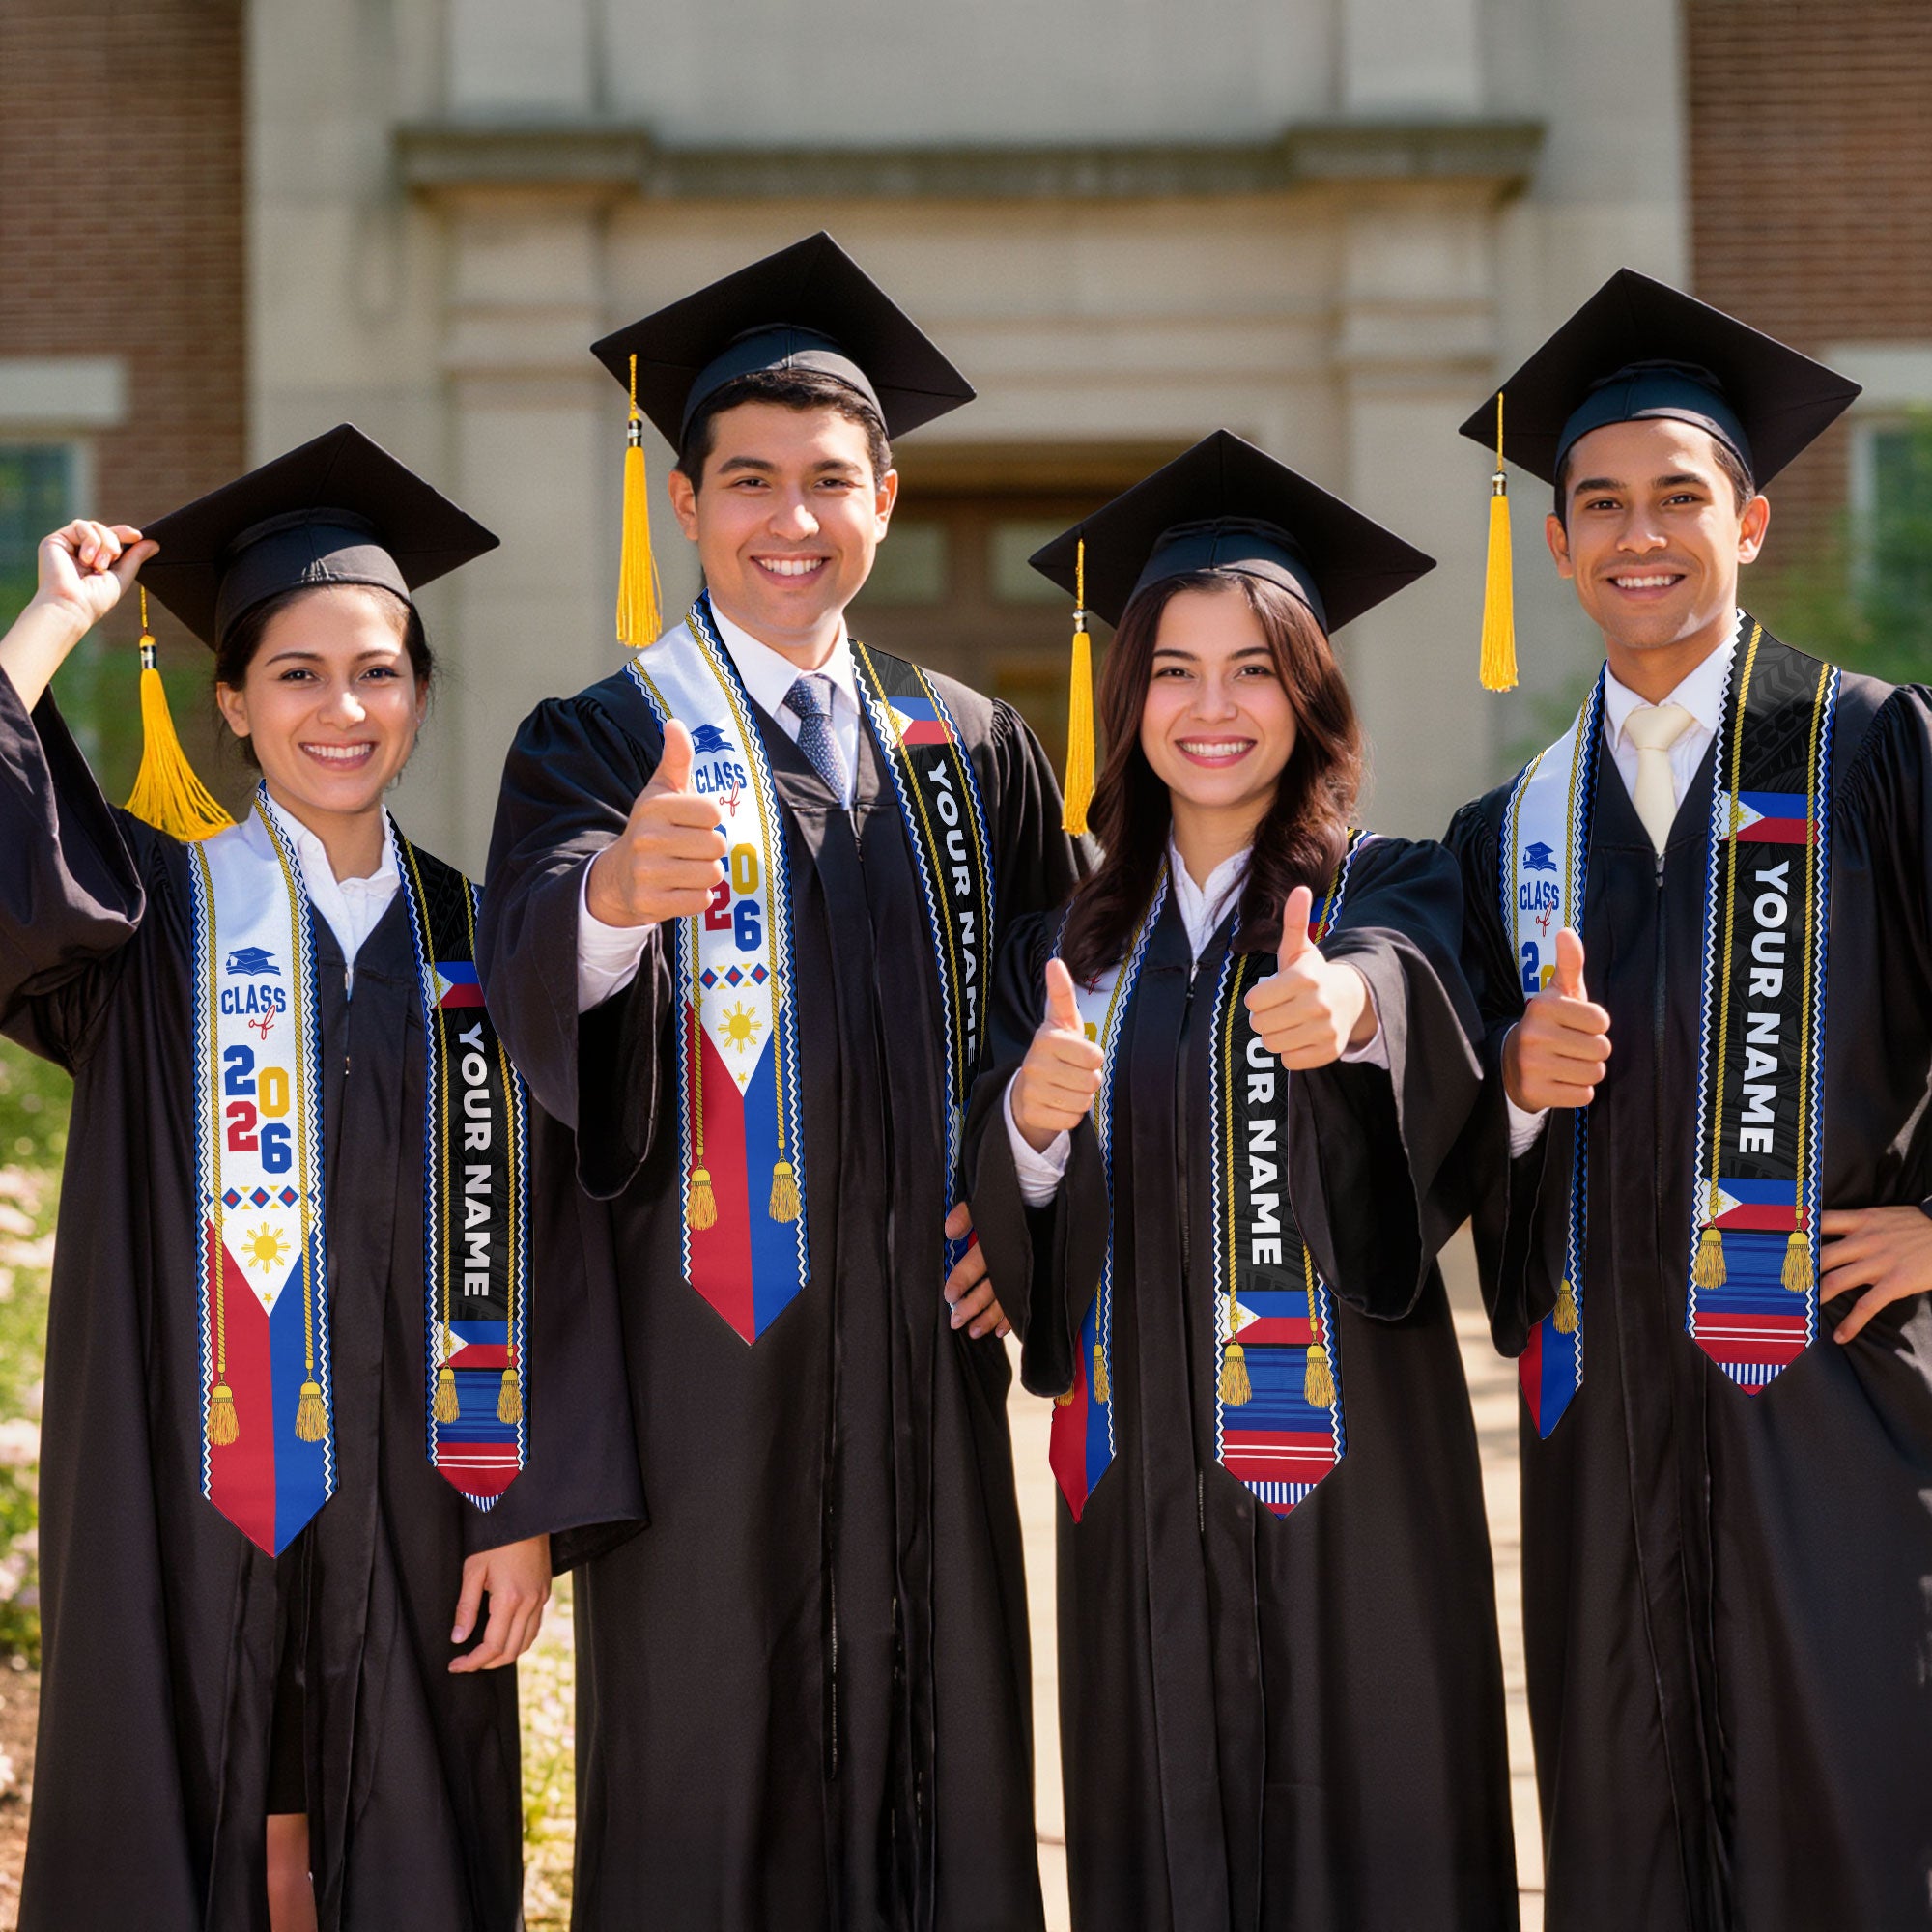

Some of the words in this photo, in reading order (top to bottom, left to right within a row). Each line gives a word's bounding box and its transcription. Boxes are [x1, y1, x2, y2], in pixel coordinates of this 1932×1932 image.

[696, 761, 747, 794] CLASS
[719, 781, 741, 817] of
[927, 759, 970, 896] YOUR
[959, 911, 977, 1066] NAME
[1520, 880, 1560, 911] CLASS
[1535, 901, 1553, 937] of
[1747, 860, 1790, 998] YOUR
[221, 984, 287, 1014] CLASS
[248, 1005, 276, 1040] of
[459, 1021, 492, 1151] YOUR
[1739, 1012, 1781, 1154] NAME
[464, 1164, 492, 1297] NAME
[1248, 1119, 1282, 1265] NAME
